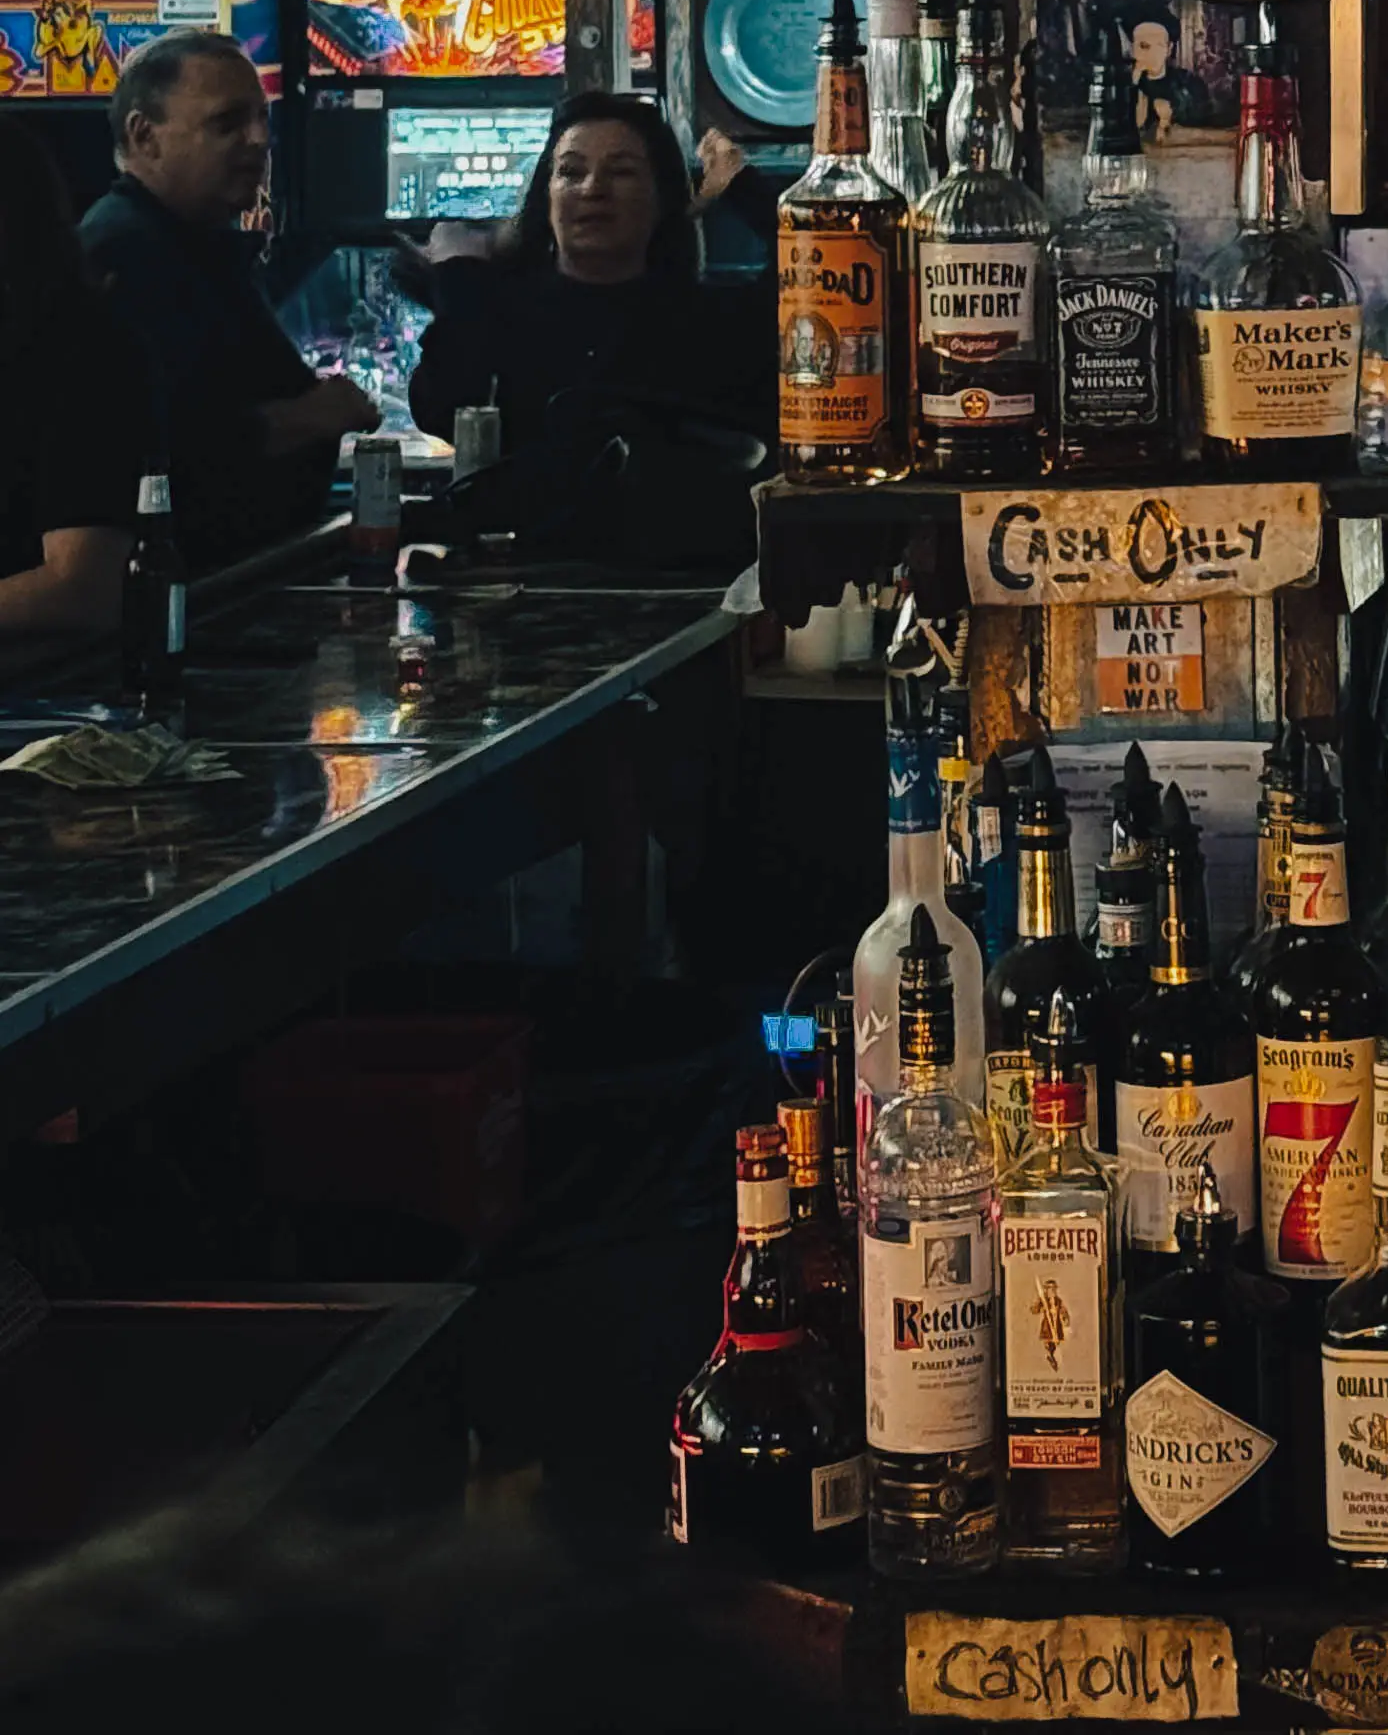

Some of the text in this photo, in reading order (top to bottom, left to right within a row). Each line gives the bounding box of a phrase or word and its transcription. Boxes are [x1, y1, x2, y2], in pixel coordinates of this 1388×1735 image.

[924, 263, 1028, 289] SOUTHERN
[930, 293, 1021, 318] COMFORT
[1057, 289, 1095, 322] JACK
[1232, 319, 1352, 344] Maker's
[1266, 347, 1350, 372] Mark
[1071, 375, 1145, 389] WHISKEY
[1255, 381, 1333, 395] WHISKY
[987, 499, 1266, 590] CASH ONLY
[1112, 606, 1183, 631] MAKE
[1126, 632, 1176, 654] ART
[1126, 661, 1178, 685] NOT
[1123, 688, 1180, 711] WAR
[1298, 870, 1328, 920] 7
[1263, 1046, 1355, 1071] Seagram's
[1137, 1108, 1234, 1138] Canadian
[1158, 1139, 1216, 1169] Club
[1264, 1096, 1359, 1265] 7
[1004, 1228, 1099, 1258] BEEFEATER
[897, 1299, 958, 1346] Ketel
[927, 1333, 975, 1352] VODKA
[1128, 1431, 1254, 1464] ENDRICK'S
[1150, 1471, 1192, 1490] GIN
[935, 1631, 1197, 1719] Cash only
